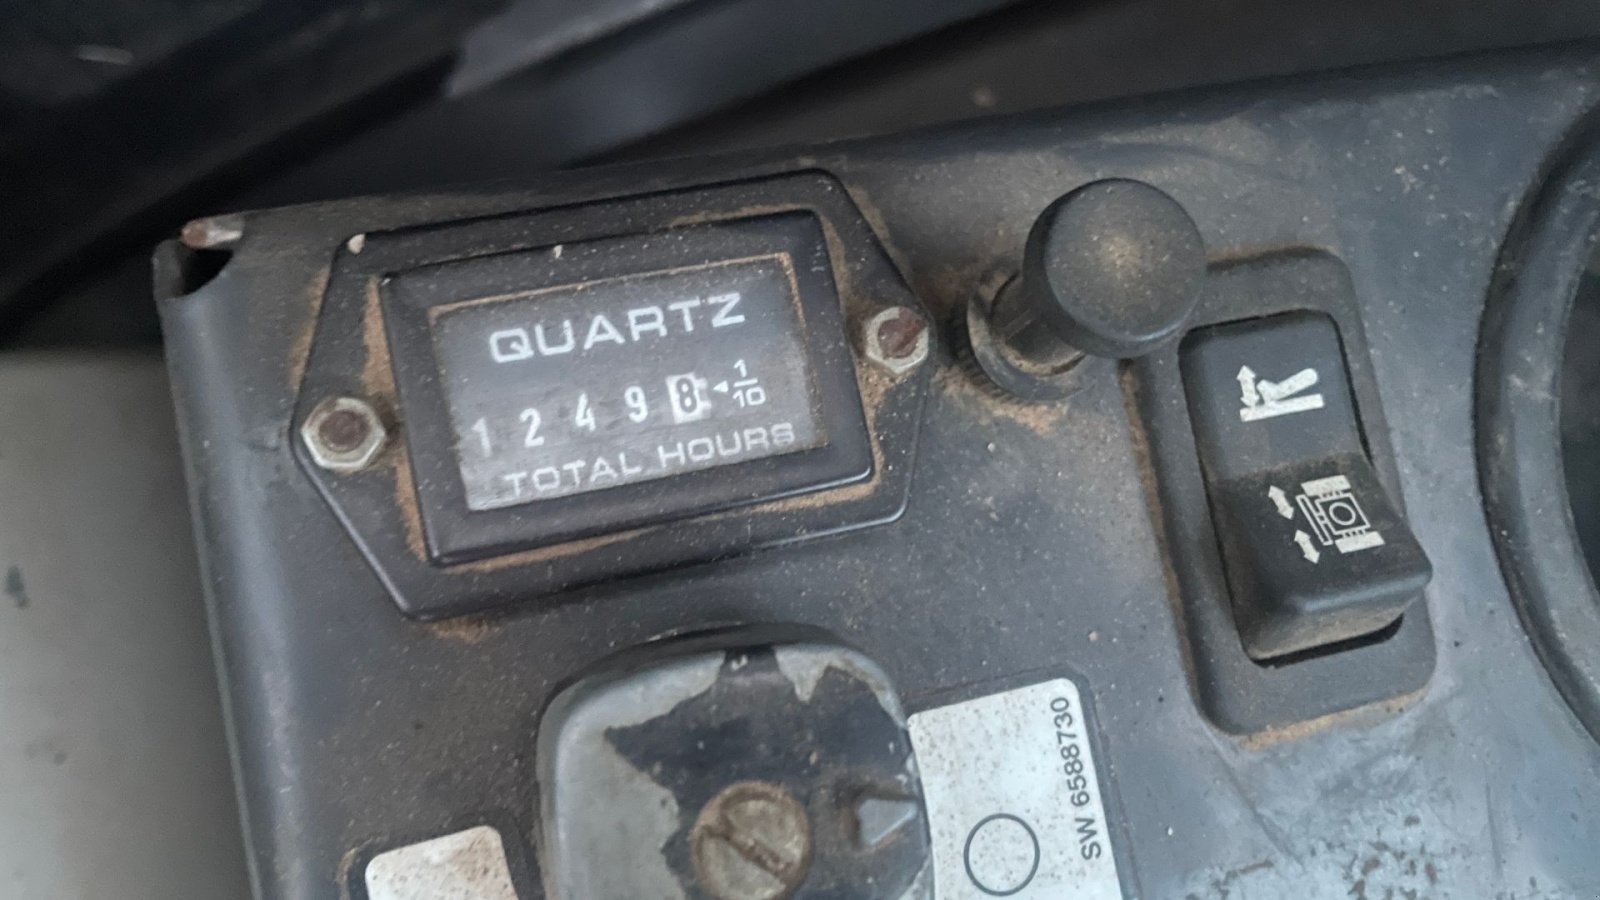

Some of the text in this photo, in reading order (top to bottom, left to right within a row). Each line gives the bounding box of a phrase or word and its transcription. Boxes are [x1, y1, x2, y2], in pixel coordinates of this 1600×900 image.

[489, 292, 746, 363] QUARTZ
[504, 422, 796, 497] TOTAL HOURS
[1050, 697, 1102, 861] SW 6588730
